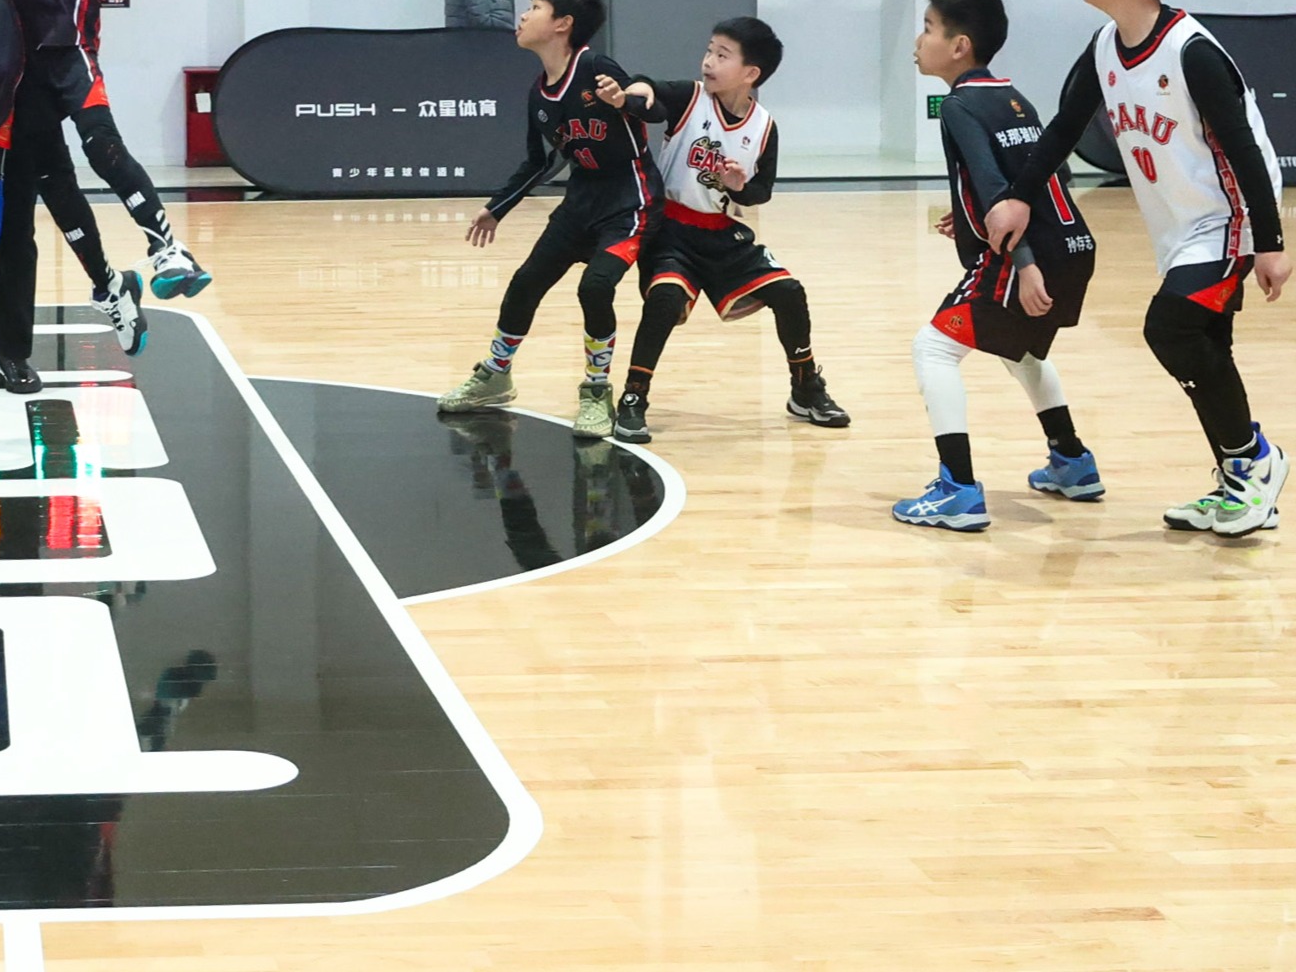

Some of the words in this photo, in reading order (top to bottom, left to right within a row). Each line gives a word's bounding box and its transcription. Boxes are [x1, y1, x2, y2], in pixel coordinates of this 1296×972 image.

[295, 103, 376, 117] PUSH
[418, 99, 497, 118] 众星体育
[1131, 146, 1158, 184] 10
